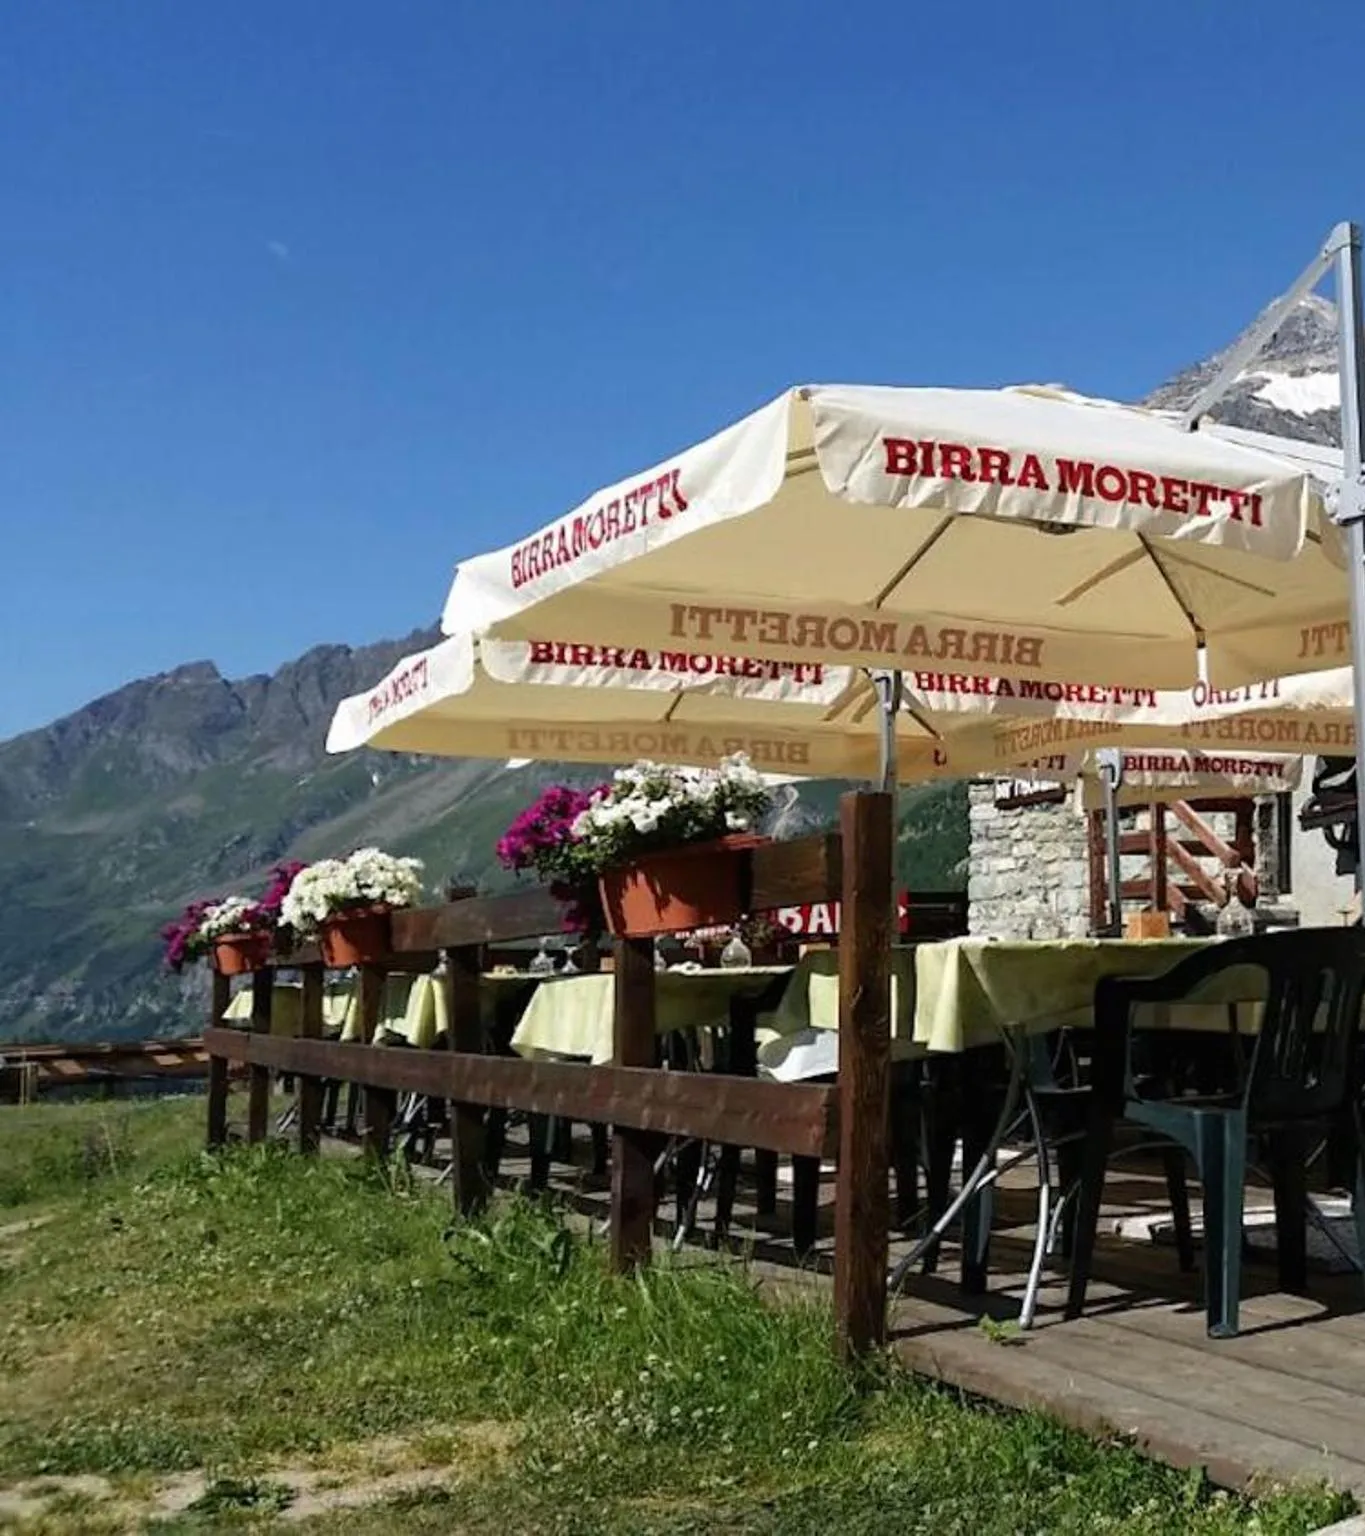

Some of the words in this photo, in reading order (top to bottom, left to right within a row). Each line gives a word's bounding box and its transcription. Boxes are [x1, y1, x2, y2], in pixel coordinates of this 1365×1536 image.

[882, 437, 1050, 492] BIRRA
[1055, 458, 1263, 527] MORETTI
[511, 524, 572, 589] BIRRA
[572, 468, 689, 558] MORETTI
[528, 640, 653, 671] BIRRA
[659, 651, 824, 685] MORETTI
[915, 671, 1014, 697] BIRRA
[1019, 679, 1157, 708] MORETTI
[1123, 754, 1190, 772] BIRRA
[1193, 756, 1285, 777] MORETTI
